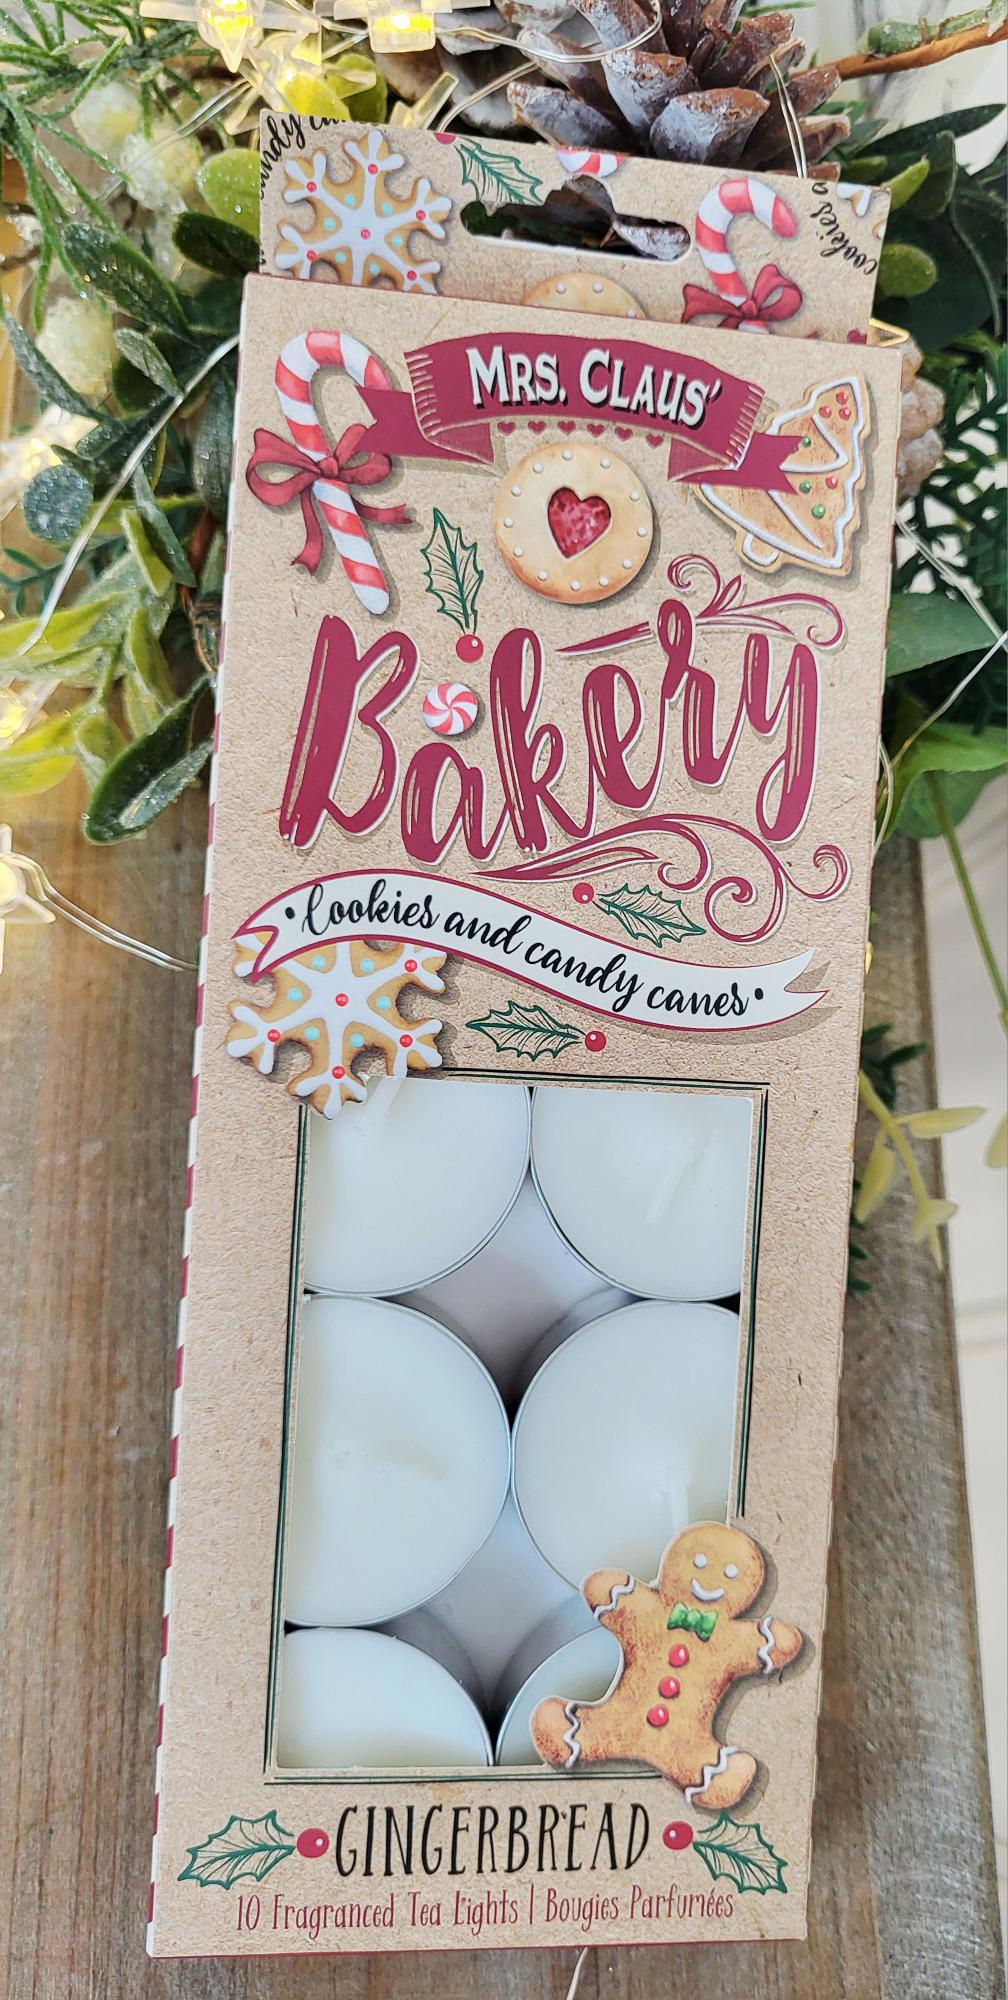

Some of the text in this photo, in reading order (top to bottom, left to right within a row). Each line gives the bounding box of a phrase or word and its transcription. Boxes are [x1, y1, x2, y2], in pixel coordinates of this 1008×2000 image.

[466, 345, 568, 408] MRS.
[279, 599, 818, 865] Bakery
[302, 878, 750, 1017] Cookies and candy canes
[335, 1803, 651, 1877] GINGERBREAD
[236, 1894, 261, 1931] 10
[272, 1893, 395, 1940] Fragranced
[408, 1891, 442, 1927] Tea
[454, 1888, 519, 1936] Lights
[545, 1887, 619, 1932] Bougies
[630, 1883, 734, 1920] Parfumées
